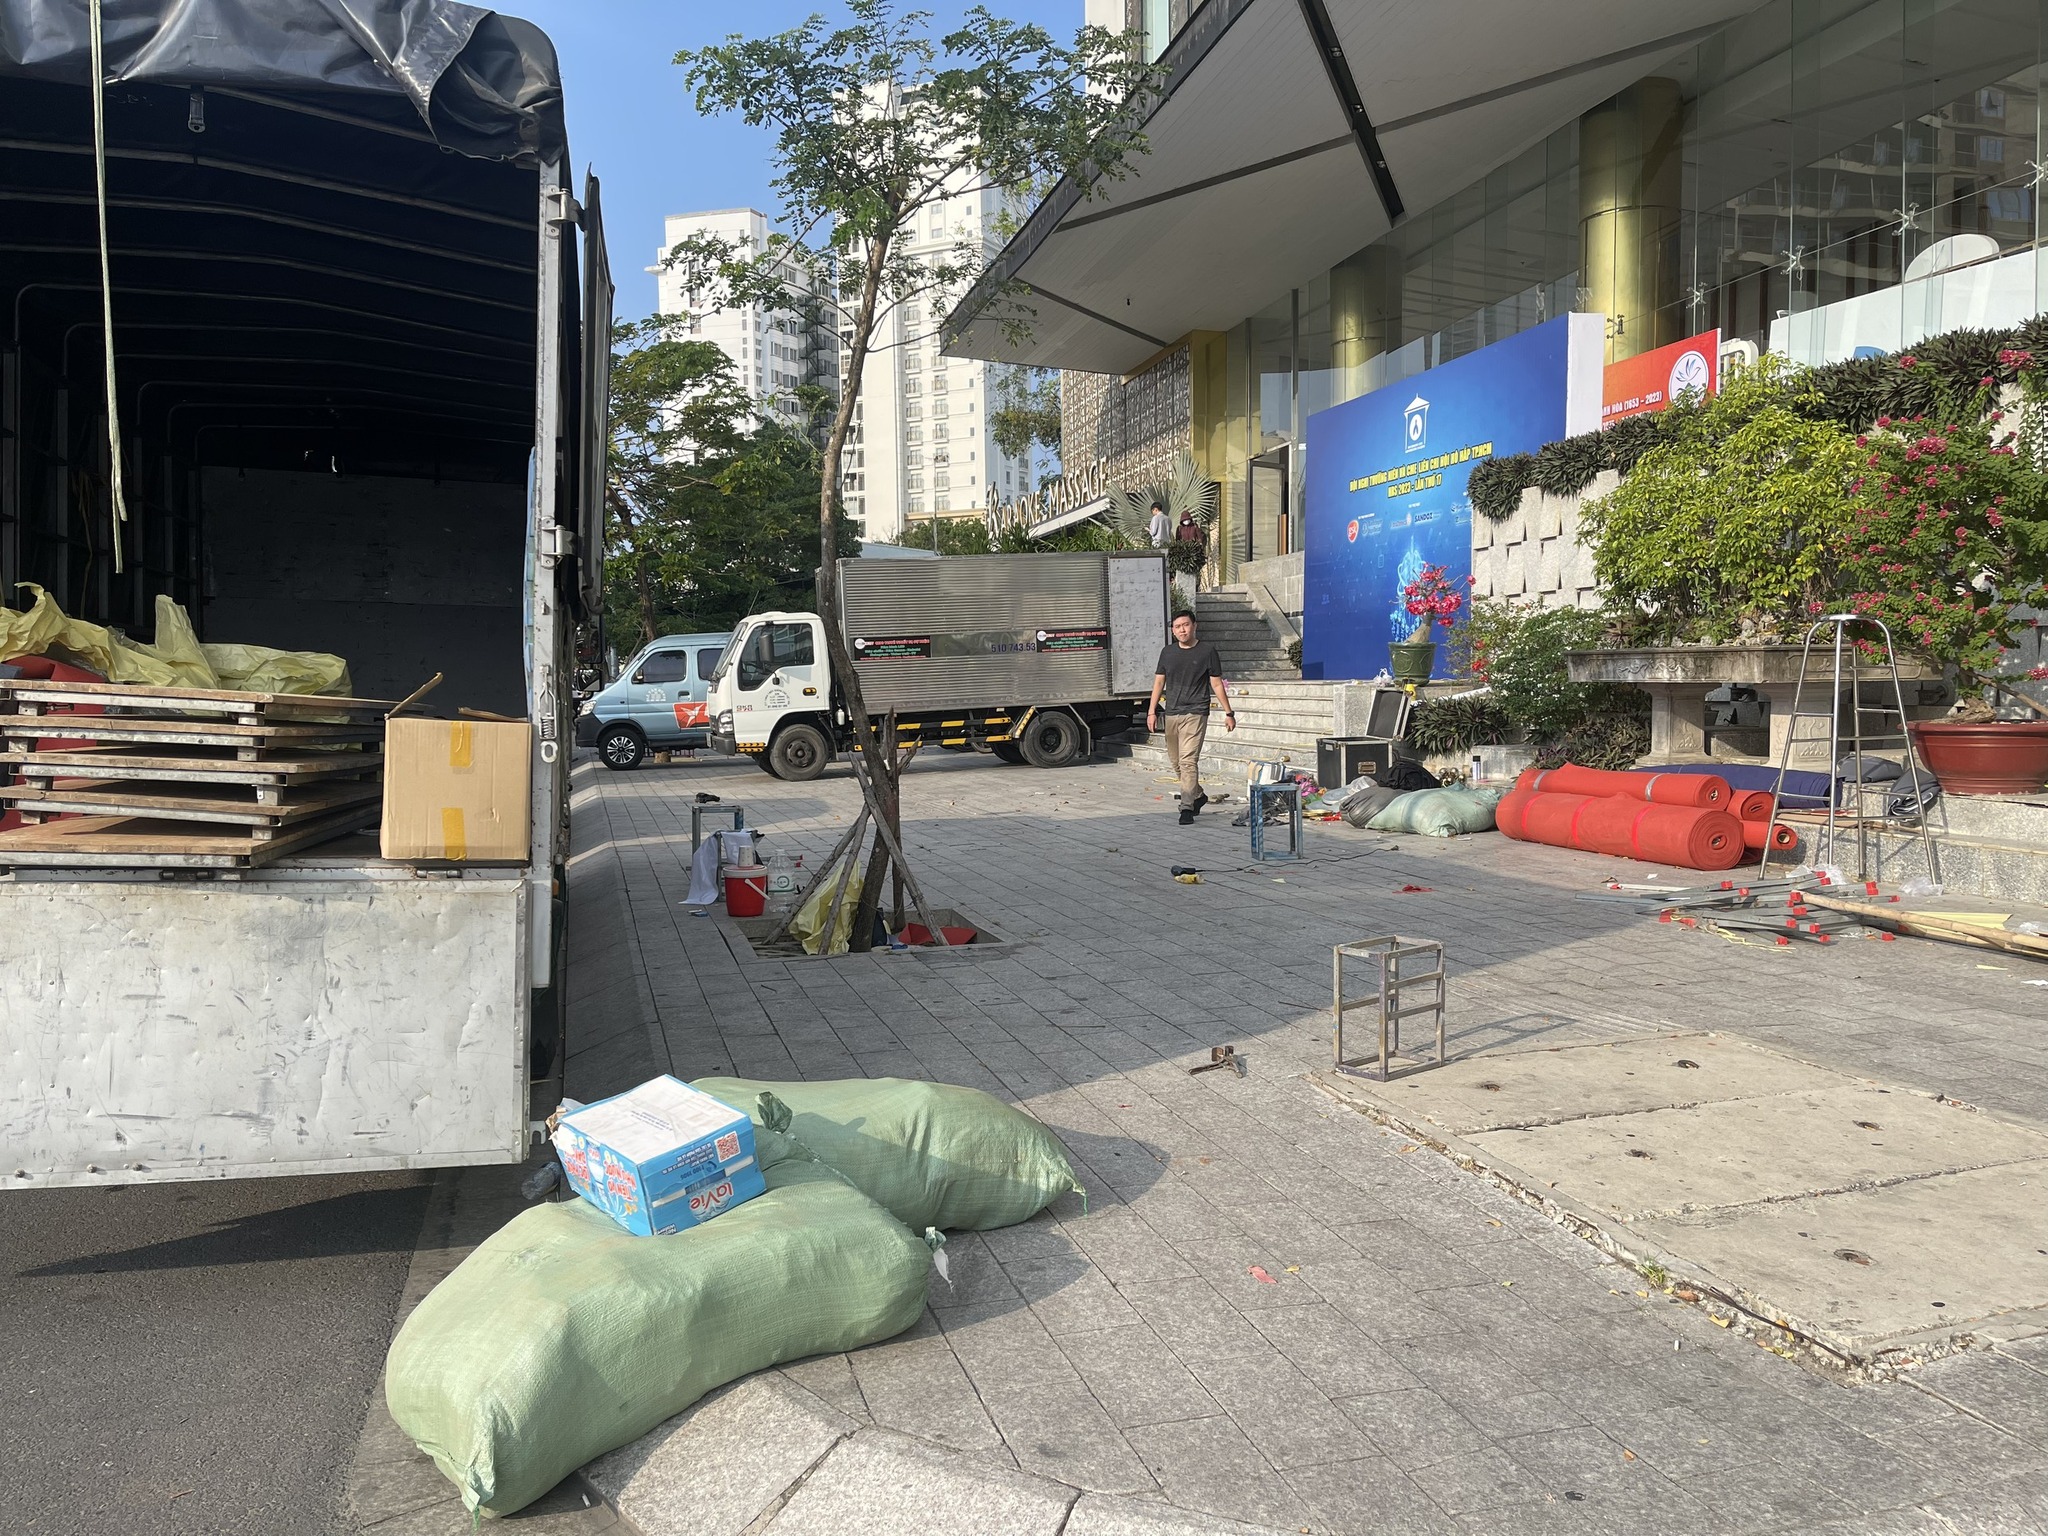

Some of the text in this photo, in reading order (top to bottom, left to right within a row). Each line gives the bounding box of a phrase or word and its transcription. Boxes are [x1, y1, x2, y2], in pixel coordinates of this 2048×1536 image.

[1645, 390, 1663, 405] 2023)
[1398, 481, 1411, 496] 2023
[985, 456, 1107, 539] KARAOKE MASSAGE
[1414, 512, 1433, 523] SANDOZ
[690, 1182, 733, 1209] laVie
